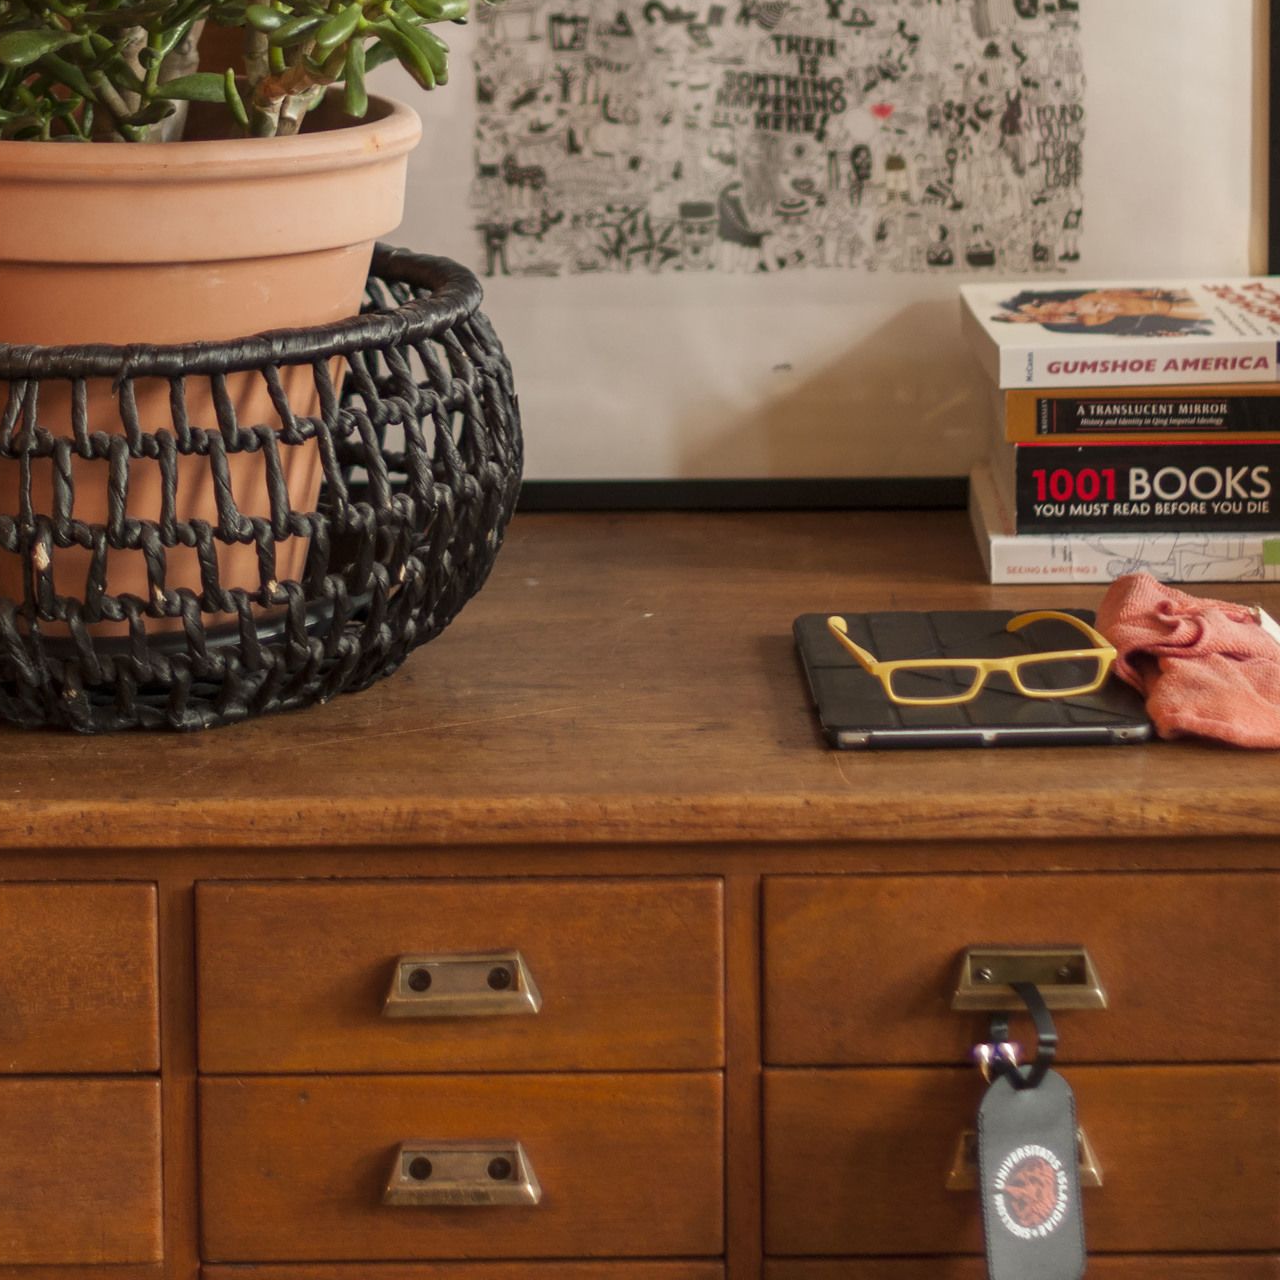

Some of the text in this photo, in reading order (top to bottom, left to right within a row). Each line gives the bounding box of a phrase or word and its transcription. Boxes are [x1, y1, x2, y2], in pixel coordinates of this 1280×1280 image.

[1046, 356, 1270, 375] GUMSHOE AMERICA
[1076, 402, 1229, 417] A TRANSLUCENT MIRROR
[1105, 417, 1117, 426] and
[1031, 465, 1272, 503] 1001 BOOKS
[1034, 500, 1270, 517] YOU MUST READ BEFORE YOU DIE
[1007, 566, 1040, 575] SEEING
[1051, 566, 1092, 575] WRITING
